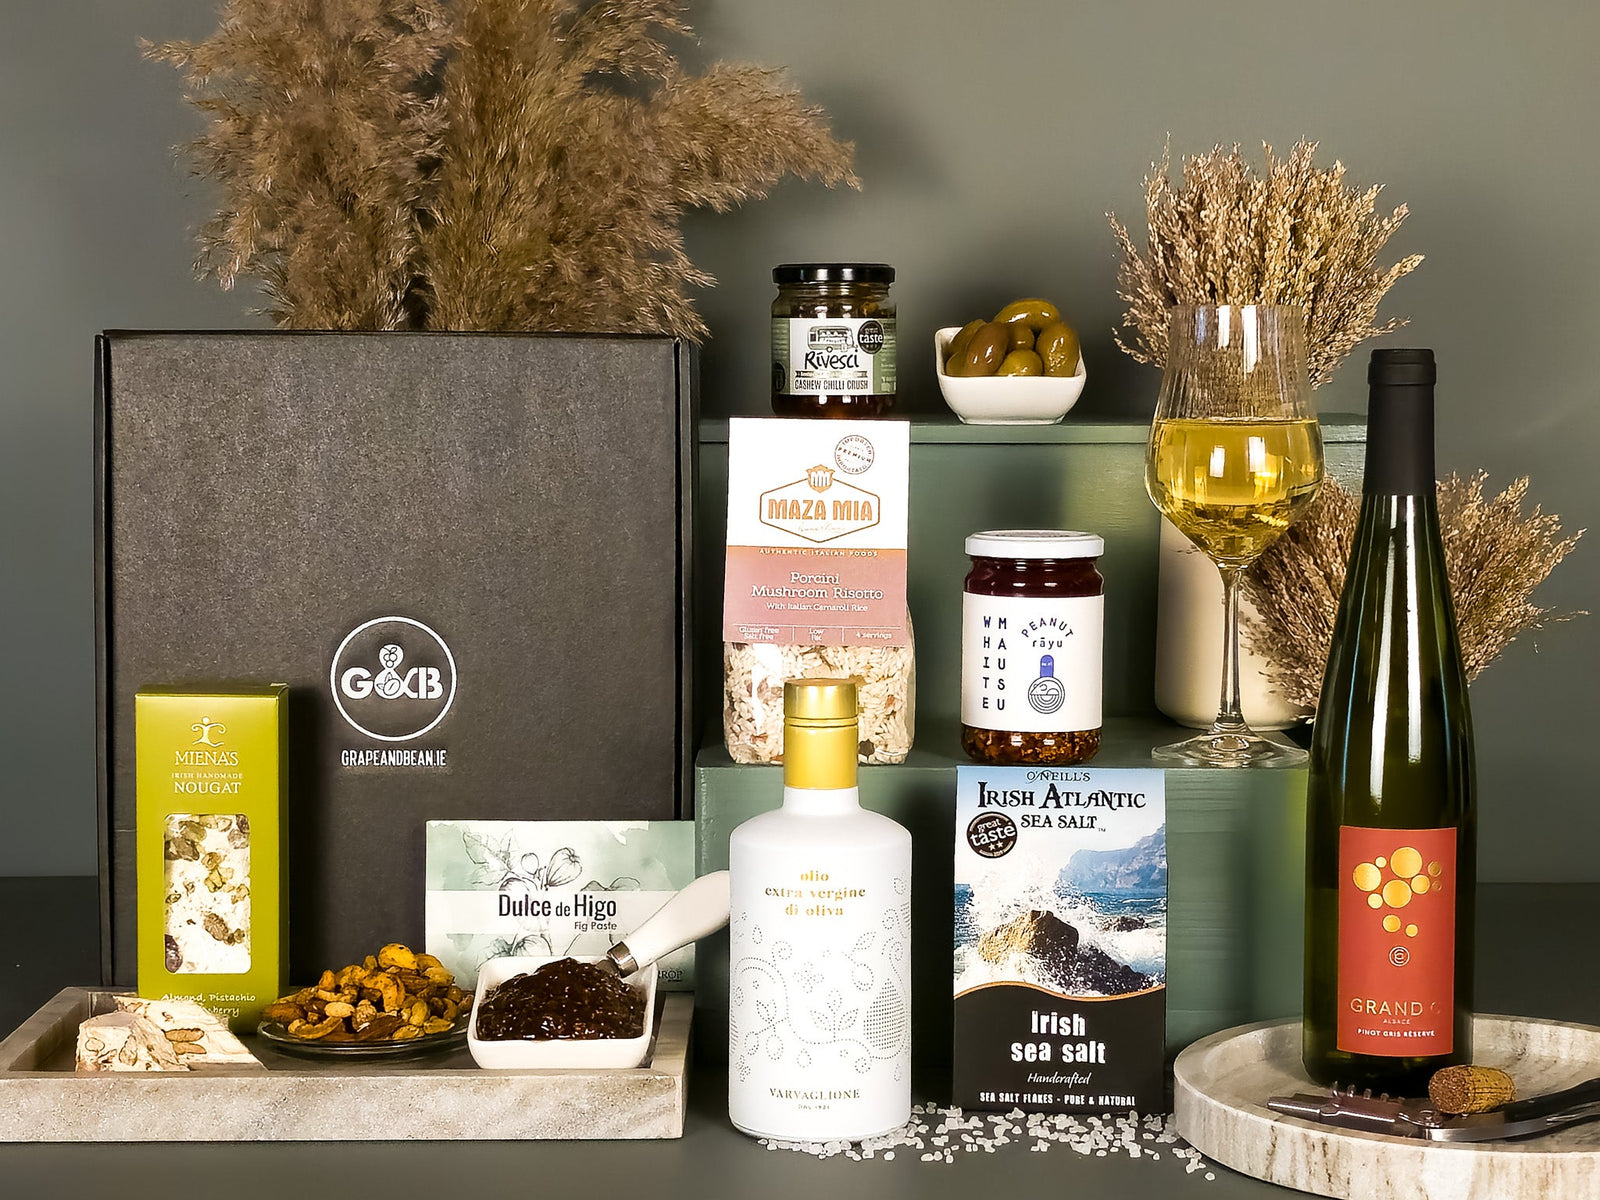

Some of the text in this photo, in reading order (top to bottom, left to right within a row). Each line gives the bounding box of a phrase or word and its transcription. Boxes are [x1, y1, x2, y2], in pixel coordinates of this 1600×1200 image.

[859, 333, 883, 344] taste
[795, 379, 868, 390] CASHEW CHILLI CRUSH
[768, 499, 873, 521] MAZA MIA
[790, 571, 840, 585] Porcini
[751, 585, 883, 600] Mushroom Risotto
[766, 602, 785, 610] With
[851, 604, 868, 612] Rice
[809, 627, 825, 635] Low
[1021, 617, 1074, 638] PEANUT
[862, 632, 892, 640] servings
[341, 750, 447, 766] GRAPEANDBEAN.IE
[1025, 769, 1091, 784] O'NEILL'S
[174, 781, 242, 794] NOUGAT
[977, 781, 1147, 811] IRISH ATLANTIC
[977, 819, 1002, 833] great
[1020, 814, 1053, 828] SEA
[1057, 814, 1097, 829] SALT
[970, 825, 1016, 846] taste
[800, 870, 829, 882] olio
[765, 887, 866, 901] extra vergine
[498, 894, 617, 921] Dulce de Higo
[785, 904, 843, 916] di oliva
[574, 922, 618, 932] Fig Paste
[160, 992, 256, 1002] Almond, Pistachio
[207, 1006, 239, 1018] berry
[1350, 998, 1423, 1016] GRAND
[1031, 1010, 1086, 1036] Irish
[1357, 1028, 1381, 1036] PINOT
[1010, 1041, 1106, 1064] sea salt
[1027, 1071, 1092, 1088] Handcrafted
[769, 1087, 861, 1100] VARVAGLIONE
[979, 1092, 996, 1102] SEA
[999, 1092, 1019, 1103] SALT
[1023, 1093, 1053, 1104] FLAKES
[1064, 1094, 1085, 1105] PURE
[1098, 1095, 1136, 1106] NATURAL
